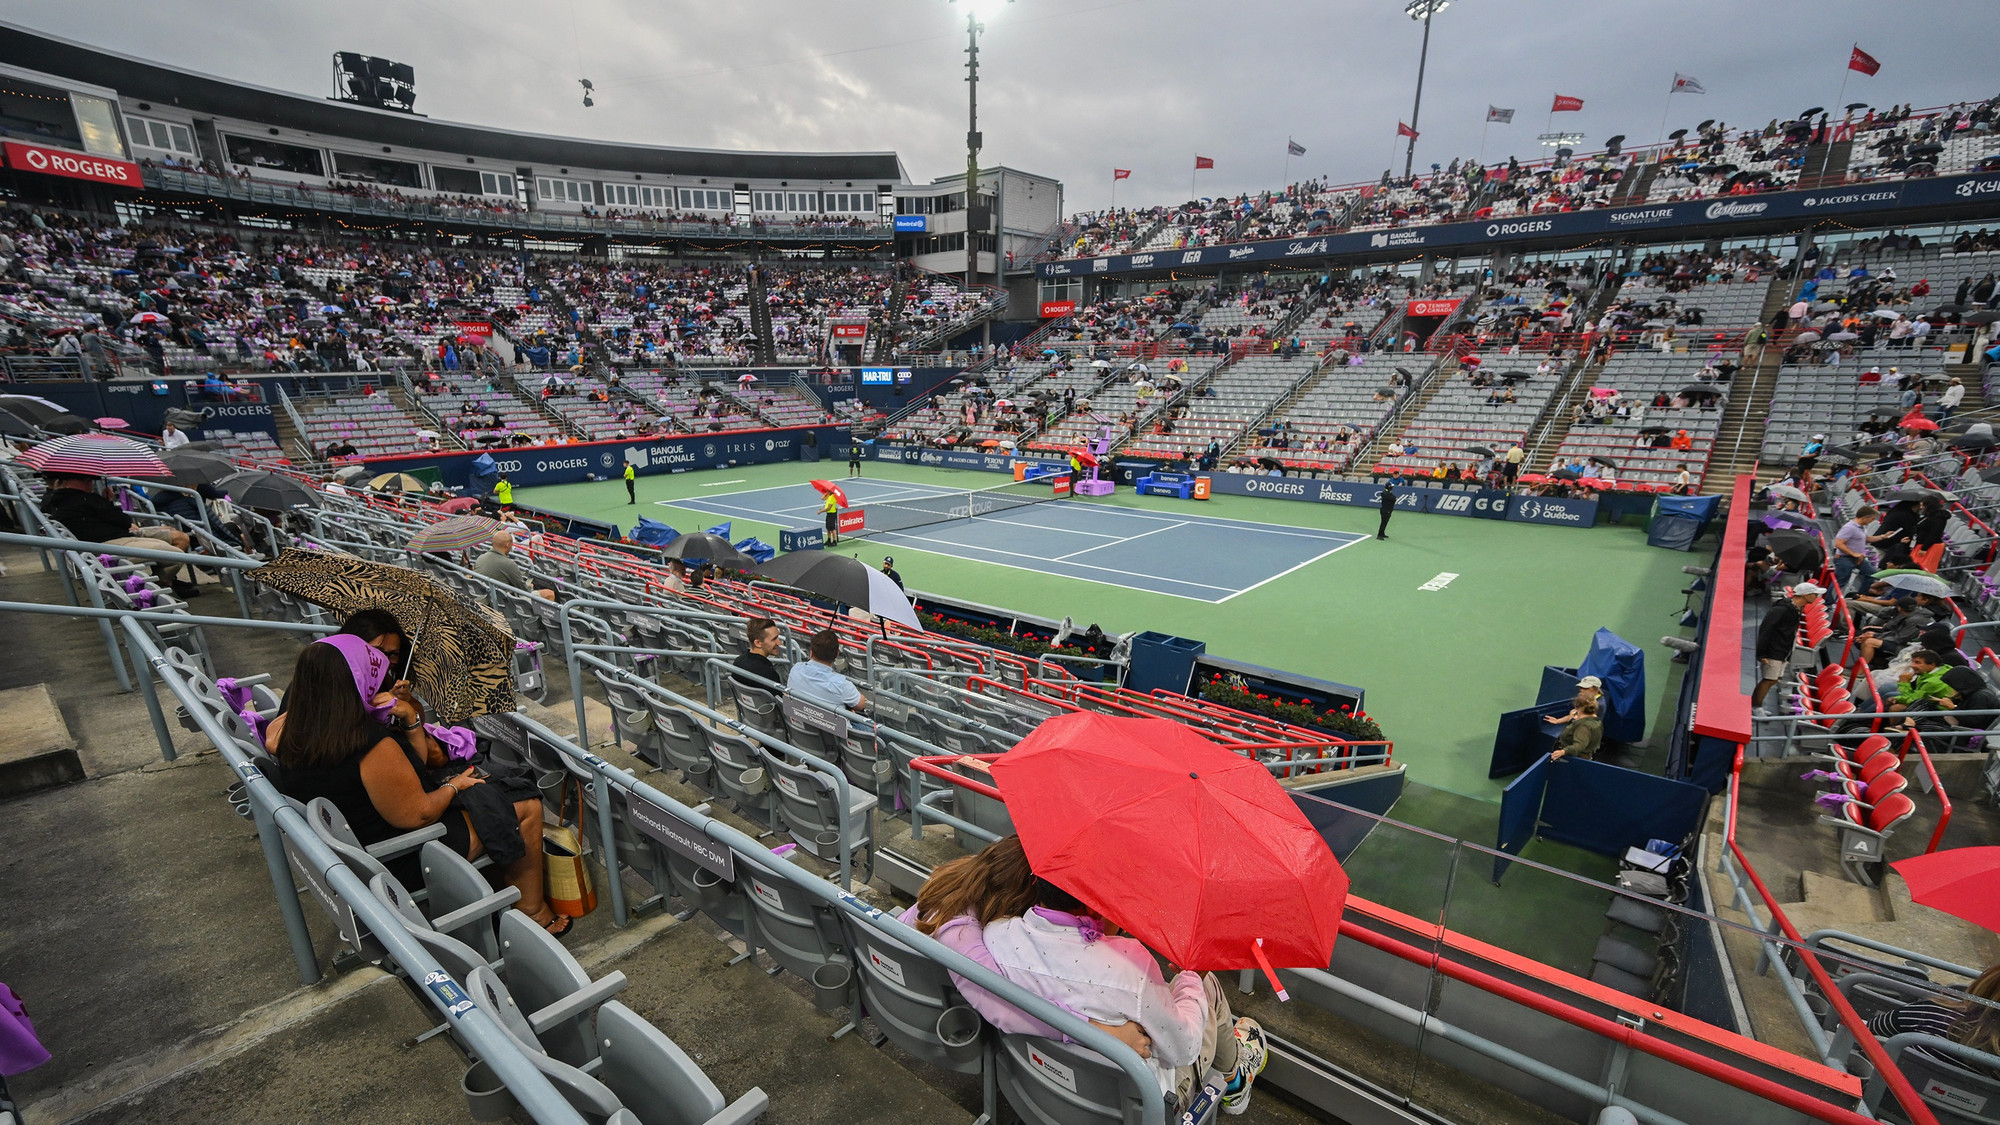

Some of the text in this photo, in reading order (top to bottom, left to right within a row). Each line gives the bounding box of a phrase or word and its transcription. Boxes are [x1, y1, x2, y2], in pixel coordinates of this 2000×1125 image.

[50, 155, 128, 181] ROGERS
[1817, 191, 1898, 206] JACOB'S CREEK
[1610, 209, 1674, 222] SIGNATURE
[1706, 201, 1768, 219] Cashmere
[1501, 220, 1553, 234] ROGERS
[1389, 237, 1425, 246] NATIONALE
[1390, 231, 1417, 240] BANQUE
[1285, 241, 1320, 256] Lindt
[1181, 251, 1202, 264] IGA
[863, 371, 891, 382] HAR-TRU
[218, 405, 272, 417] ROGERS
[650, 445, 684, 456] BANQUE
[549, 458, 588, 470] ROGERS
[652, 453, 695, 465] NATIONALE
[984, 457, 1004, 465] PERONI
[1124, 470, 1132, 479] G
[1195, 483, 1205, 495] G
[1259, 482, 1305, 495] ROGERS
[1321, 484, 1332, 492] LA
[1319, 492, 1352, 502] PRESSE
[1435, 494, 1471, 511] IGA
[1475, 498, 1505, 512] G G
[1544, 503, 1565, 512] Loto
[840, 516, 864, 527] Emirates
[1542, 510, 1580, 521] Québec
[525, 675, 535, 688] J
[632, 807, 662, 832] Marchand
[708, 851, 726, 867] DVM
[1853, 840, 1869, 852] A
